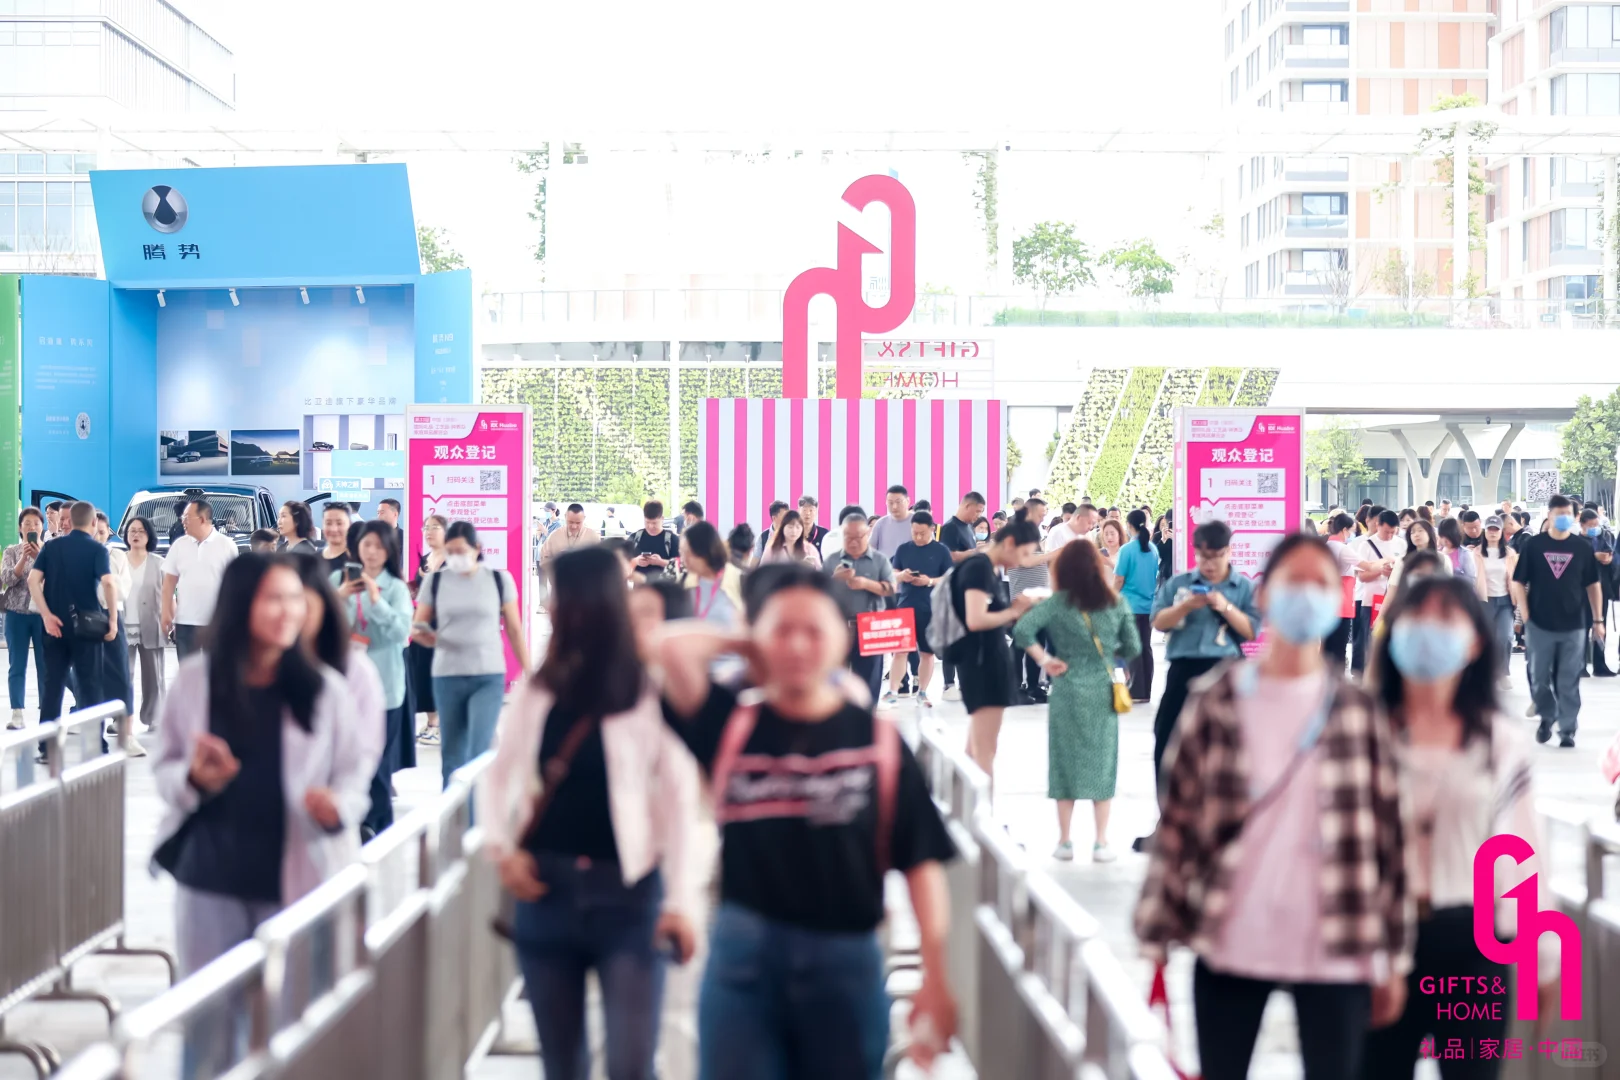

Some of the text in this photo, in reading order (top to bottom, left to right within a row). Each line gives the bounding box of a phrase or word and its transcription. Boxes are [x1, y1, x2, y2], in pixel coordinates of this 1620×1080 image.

[142, 243, 200, 260] 腾势
[304, 397, 397, 406] 比亚迪旗下豪华品牌
[433, 445, 496, 460] 观众登记
[1211, 448, 1274, 463] 观众登记
[430, 475, 475, 485] 1 扫码关注
[1208, 477, 1252, 488] 1 扫码关注
